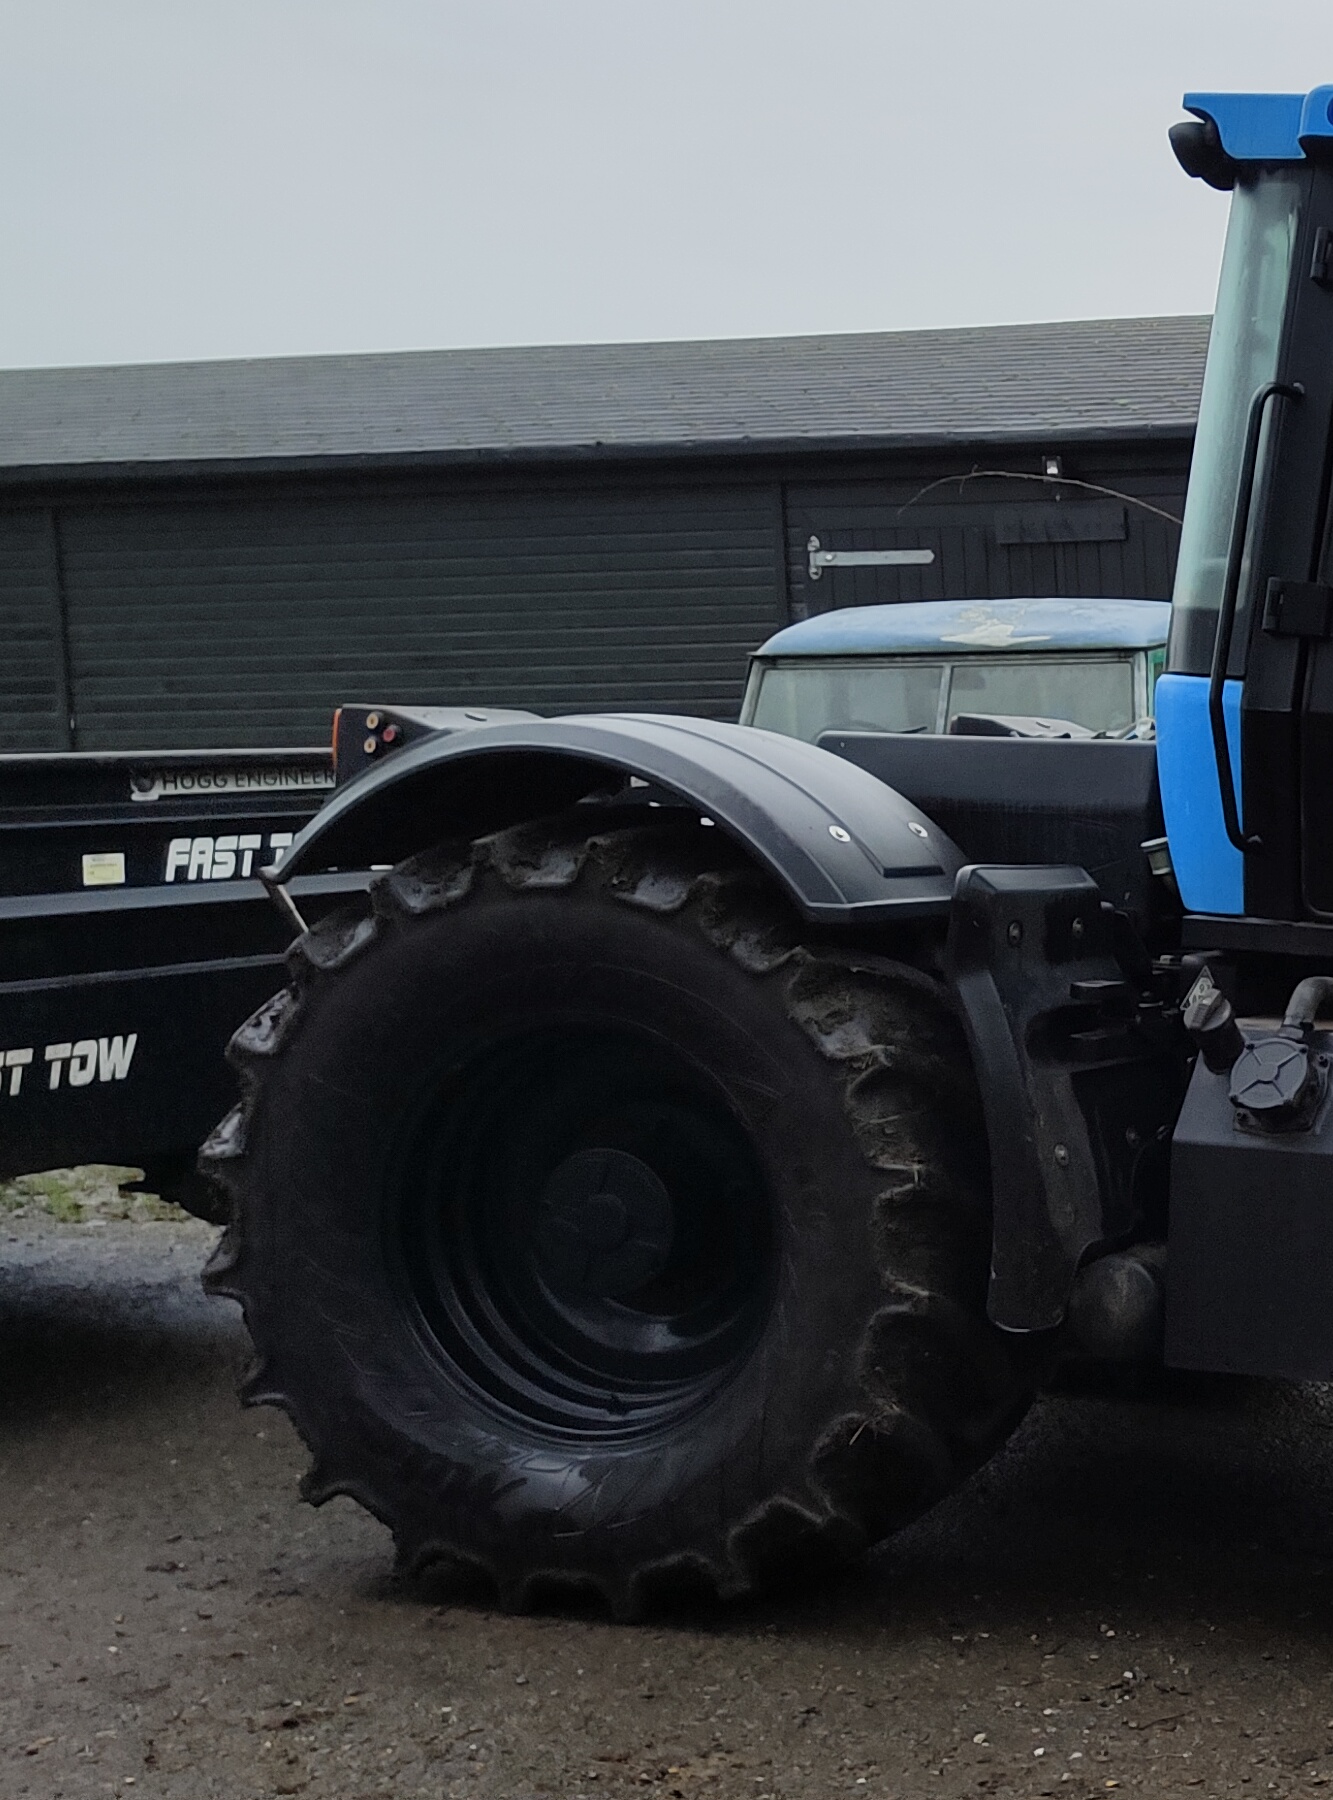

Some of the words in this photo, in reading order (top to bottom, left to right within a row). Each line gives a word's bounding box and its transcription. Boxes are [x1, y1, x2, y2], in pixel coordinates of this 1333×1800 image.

[162, 774, 228, 791] HOGG
[165, 834, 262, 883] FAST
[44, 1033, 138, 1090] TOW
